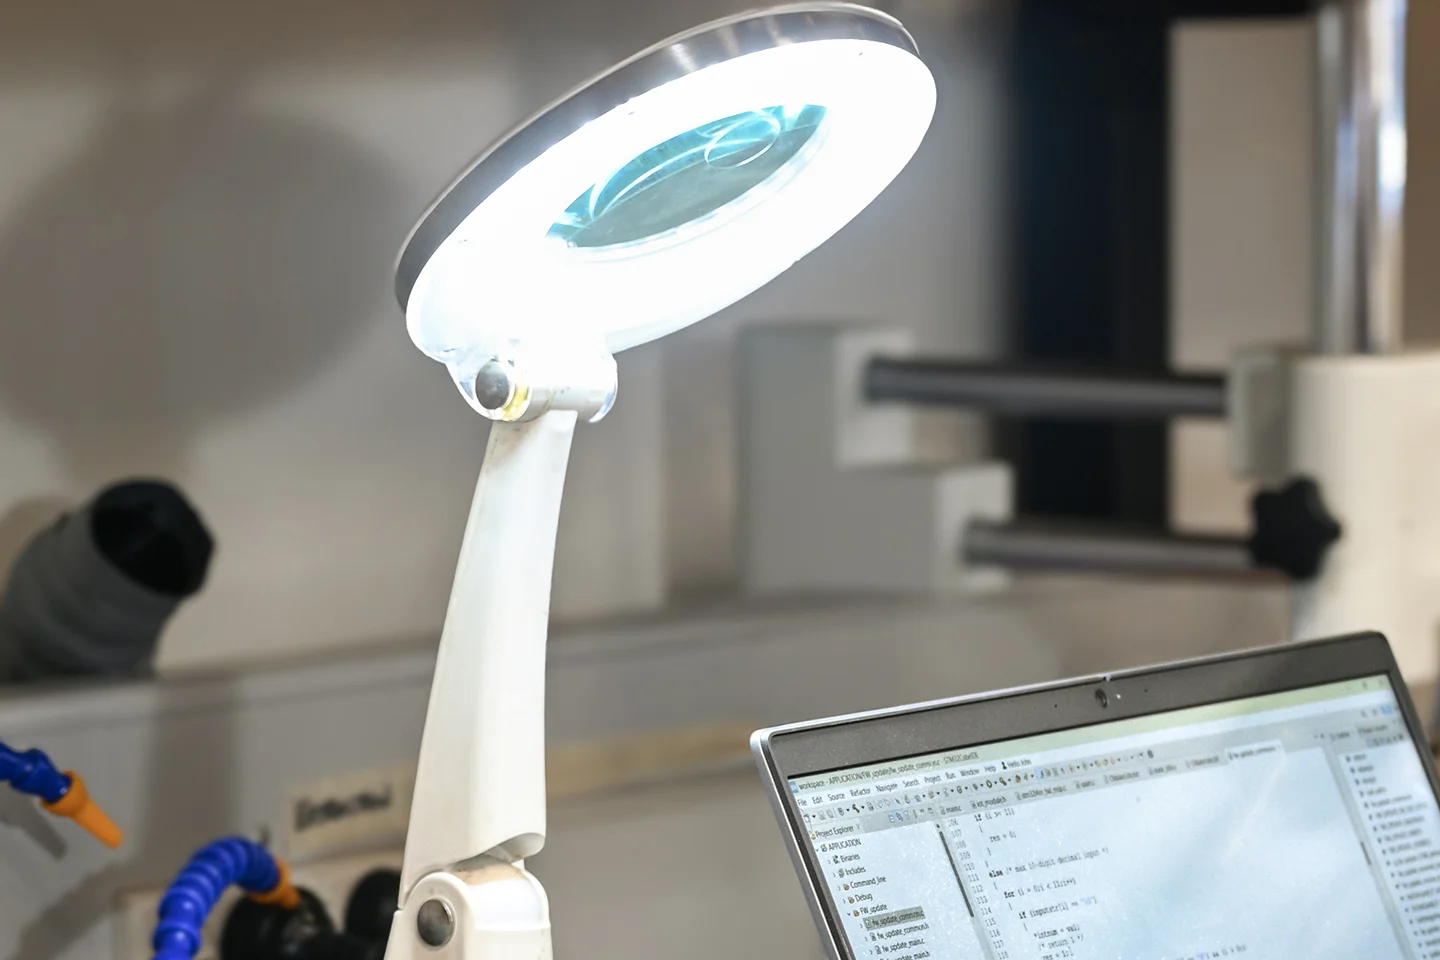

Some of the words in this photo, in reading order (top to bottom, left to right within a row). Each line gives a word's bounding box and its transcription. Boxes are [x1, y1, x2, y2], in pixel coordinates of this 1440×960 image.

[796, 798, 808, 807] File
[811, 795, 823, 805] Edit
[826, 792, 846, 802] Source
[849, 787, 871, 797] Refactor
[874, 782, 898, 792] Navigate
[901, 778, 920, 788] Search
[923, 774, 942, 785] Project
[944, 771, 956, 780] Run
[959, 768, 980, 777] Window
[983, 765, 997, 773] Help
[797, 780, 826, 790] workspace
[814, 827, 837, 839] Project
[835, 825, 854, 835] Explorer
[827, 837, 862, 851] APPLICATION
[839, 853, 861, 863] Binaries
[844, 865, 867, 876] Includes
[988, 869, 1004, 878] else
[849, 875, 887, 889] Command_line
[853, 892, 874, 902] Debug
[1003, 890, 1015, 899] for
[858, 903, 888, 915] FW_update
[1018, 910, 1027, 920] if
[871, 909, 925, 927] fw_update_common.c
[875, 922, 930, 940] fw_update_common.h
[880, 937, 925, 953] fw_update_main.c
